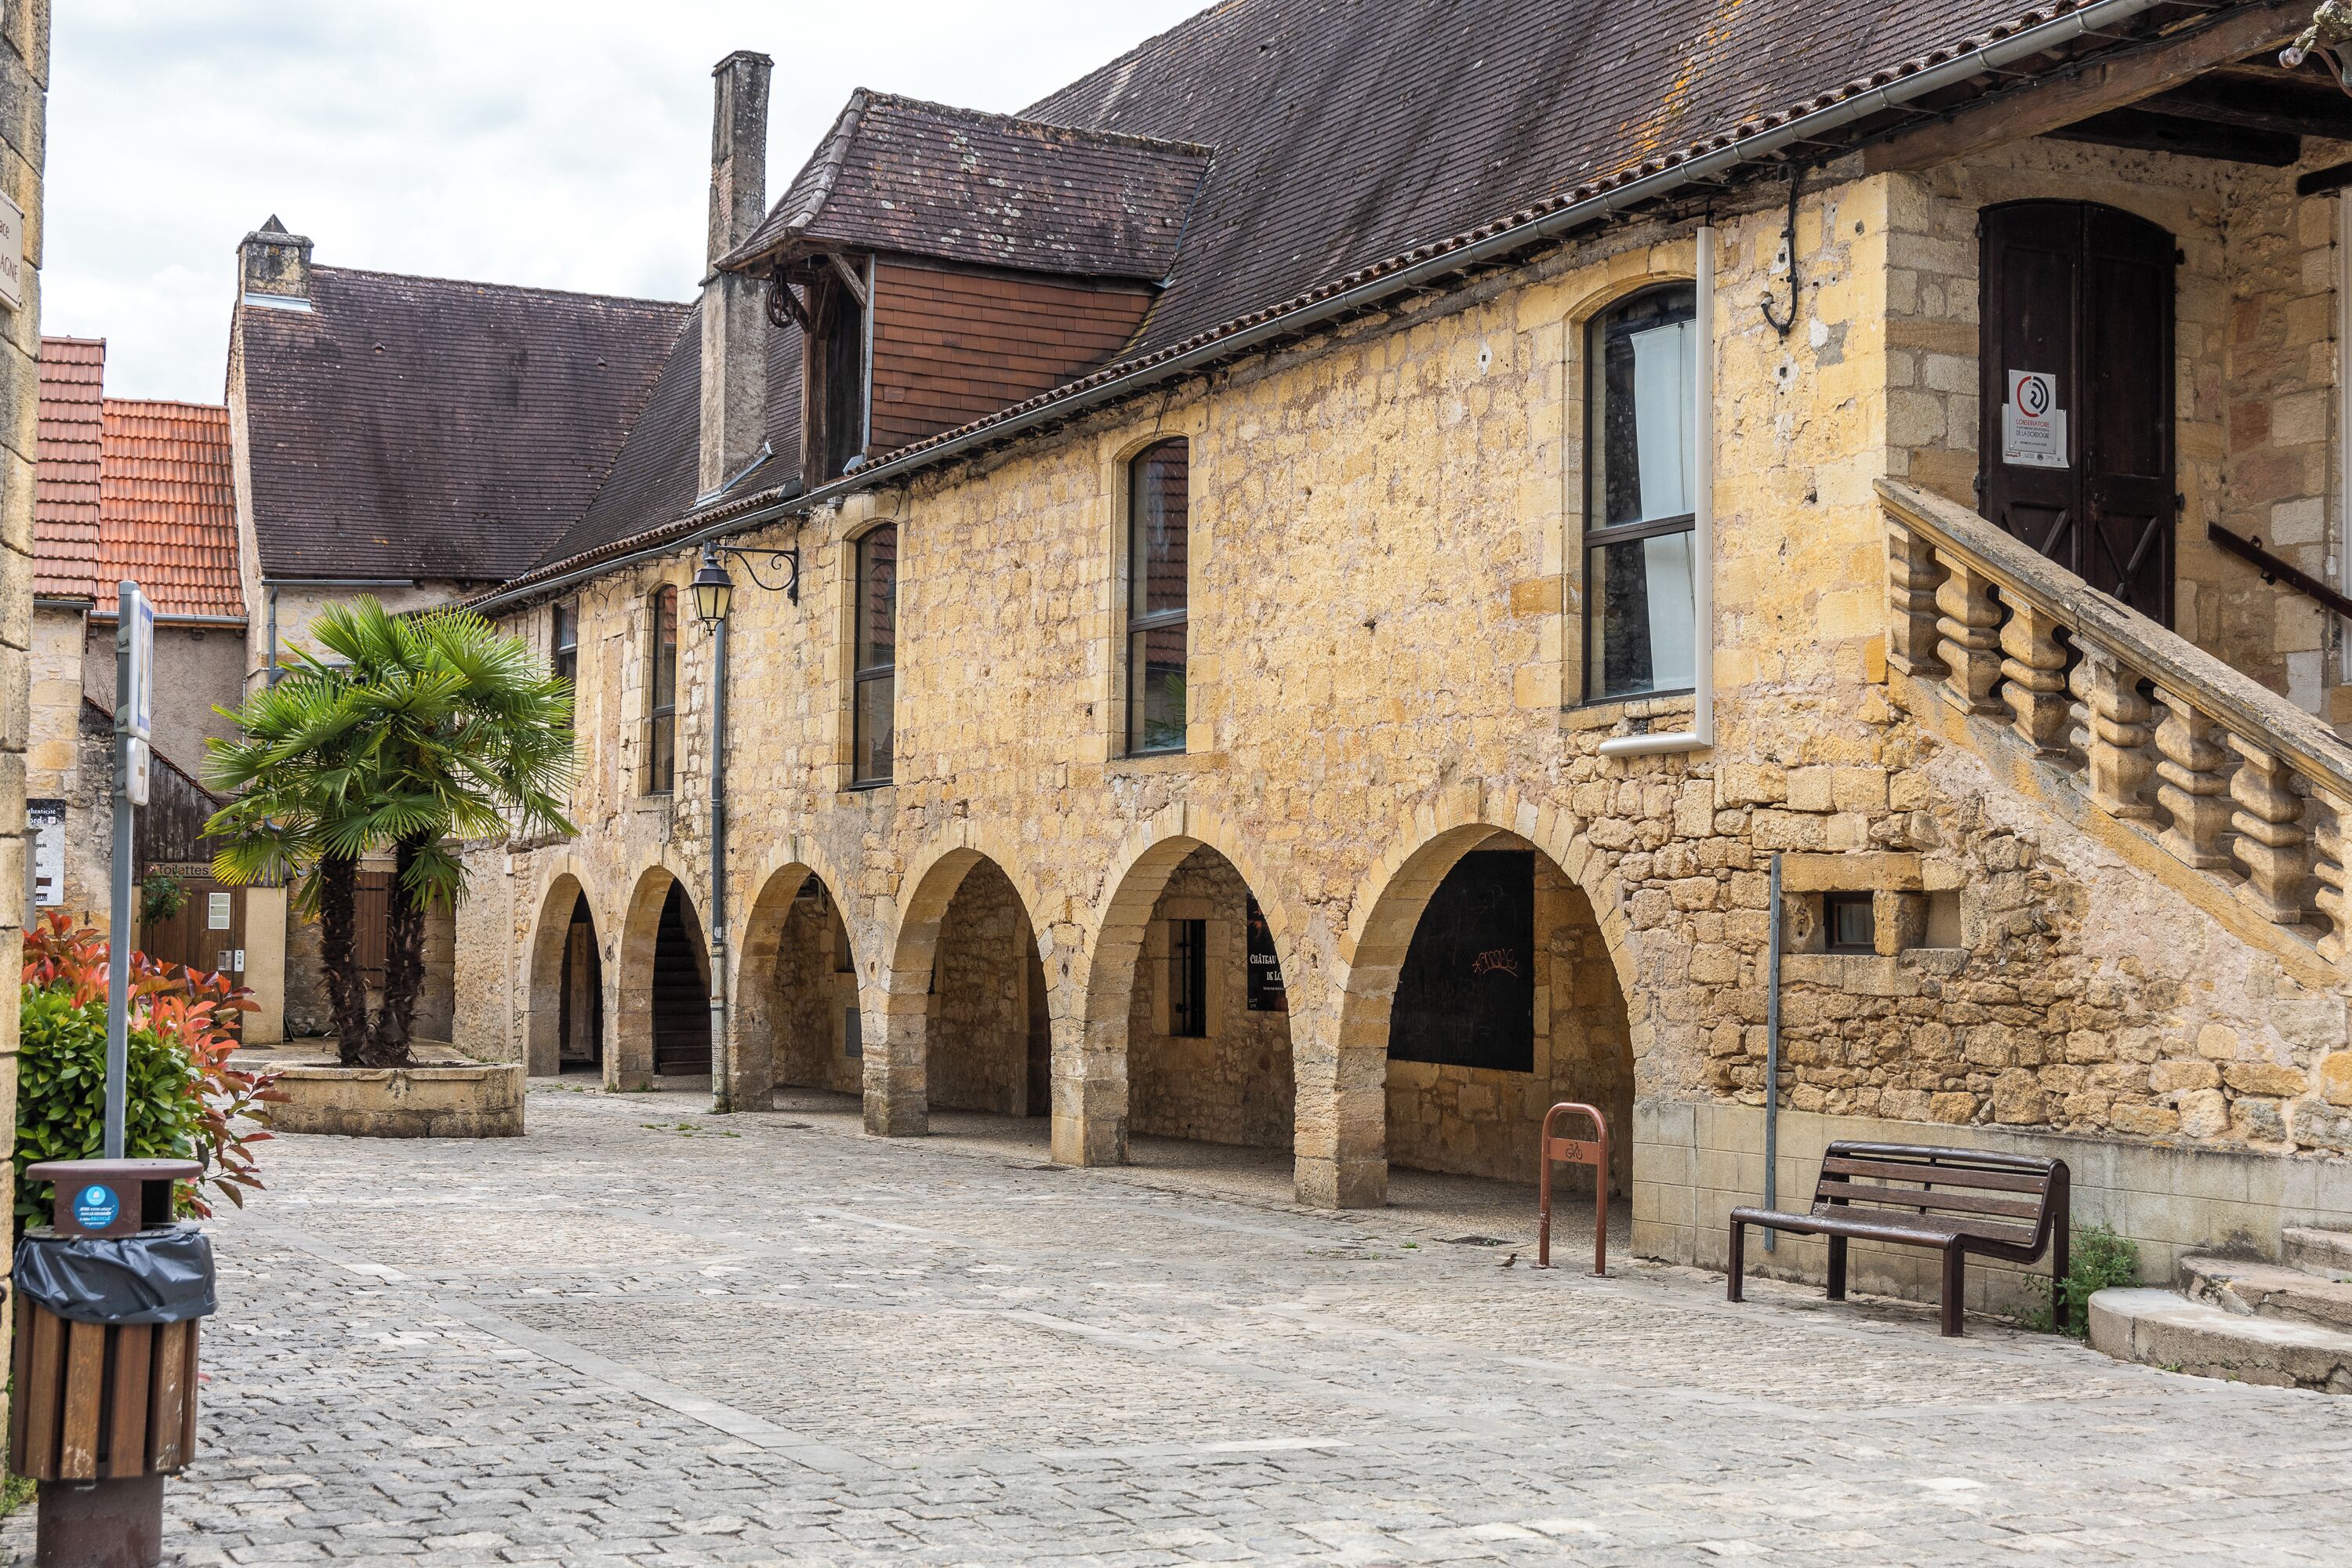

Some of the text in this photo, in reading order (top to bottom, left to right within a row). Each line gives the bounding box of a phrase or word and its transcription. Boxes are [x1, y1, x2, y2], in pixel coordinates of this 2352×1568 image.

[0, 220, 9, 239] ace
[0, 252, 17, 283] AGNE
[2016, 419, 2049, 428] CONSERVATOIRE
[157, 863, 209, 876] Toilettes
[1274, 971, 1283, 981] LO
